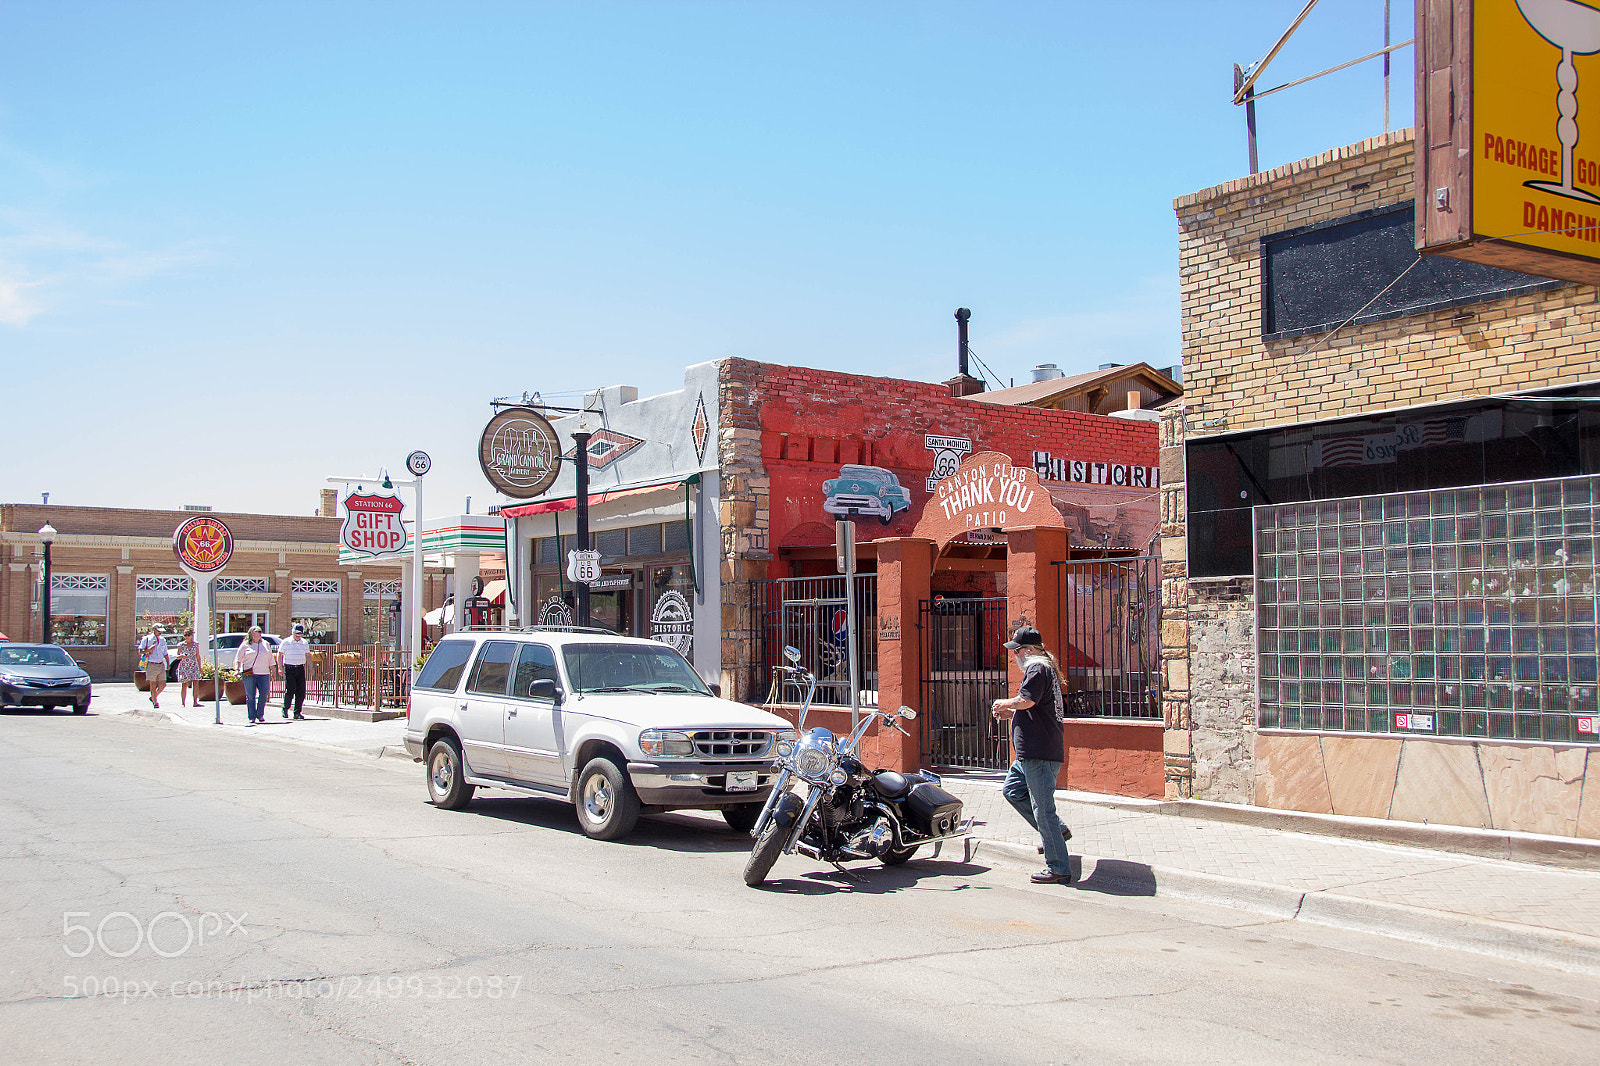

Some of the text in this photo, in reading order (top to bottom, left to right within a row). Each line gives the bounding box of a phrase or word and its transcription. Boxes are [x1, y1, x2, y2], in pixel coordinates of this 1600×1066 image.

[1484, 132, 1600, 188] PACKAGE GO
[1523, 201, 1600, 243] DANCIN
[927, 438, 969, 450] SANTA MONICA
[415, 460, 426, 469] 66
[496, 453, 544, 468] GRAND CANYON
[937, 457, 956, 477] 66
[938, 463, 1027, 499] CANYON CLUB
[354, 500, 384, 508] STATION
[940, 477, 1035, 521] THANK YOU
[182, 519, 228, 537] ITALIAN BISTRO
[356, 512, 394, 530] GIFT
[966, 510, 1006, 528] PATIO
[351, 530, 400, 549] SHOP
[580, 566, 593, 578] 66
[654, 624, 691, 633] HISTORIC
